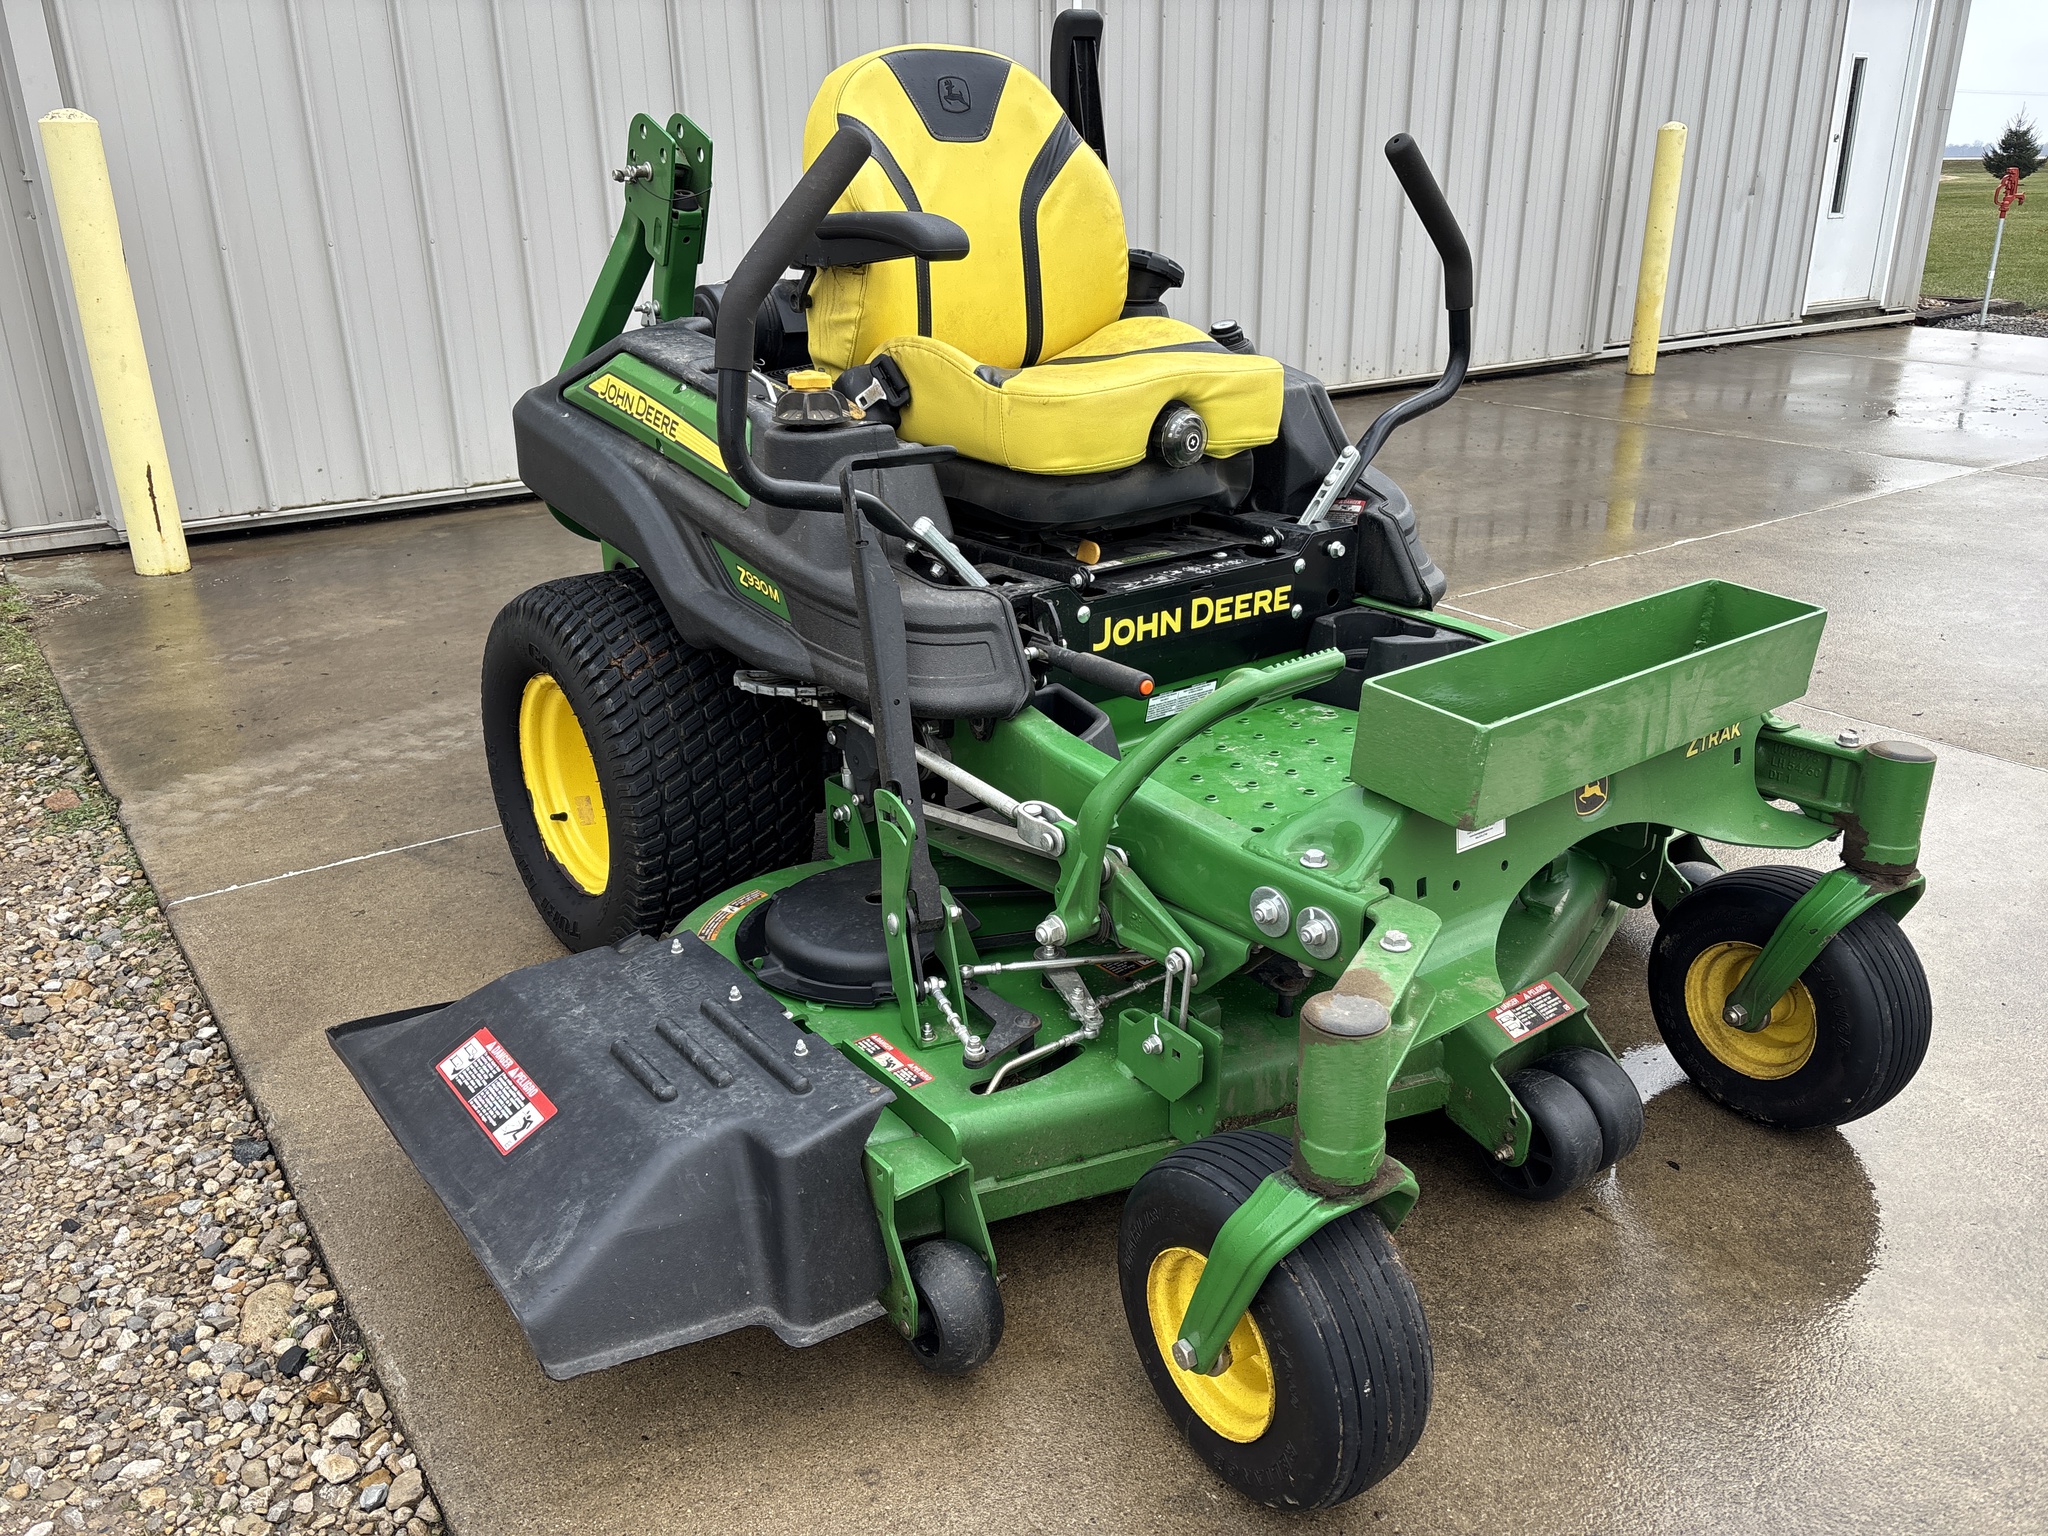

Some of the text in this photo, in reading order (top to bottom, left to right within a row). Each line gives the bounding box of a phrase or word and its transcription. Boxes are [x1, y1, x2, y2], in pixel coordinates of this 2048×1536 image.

[600, 378, 680, 439] JOHN DEERE
[736, 565, 780, 603] Z930M
[1092, 584, 1292, 652] JOHN DEERE
[491, 1045, 538, 1098] DANGER PELIGRO
